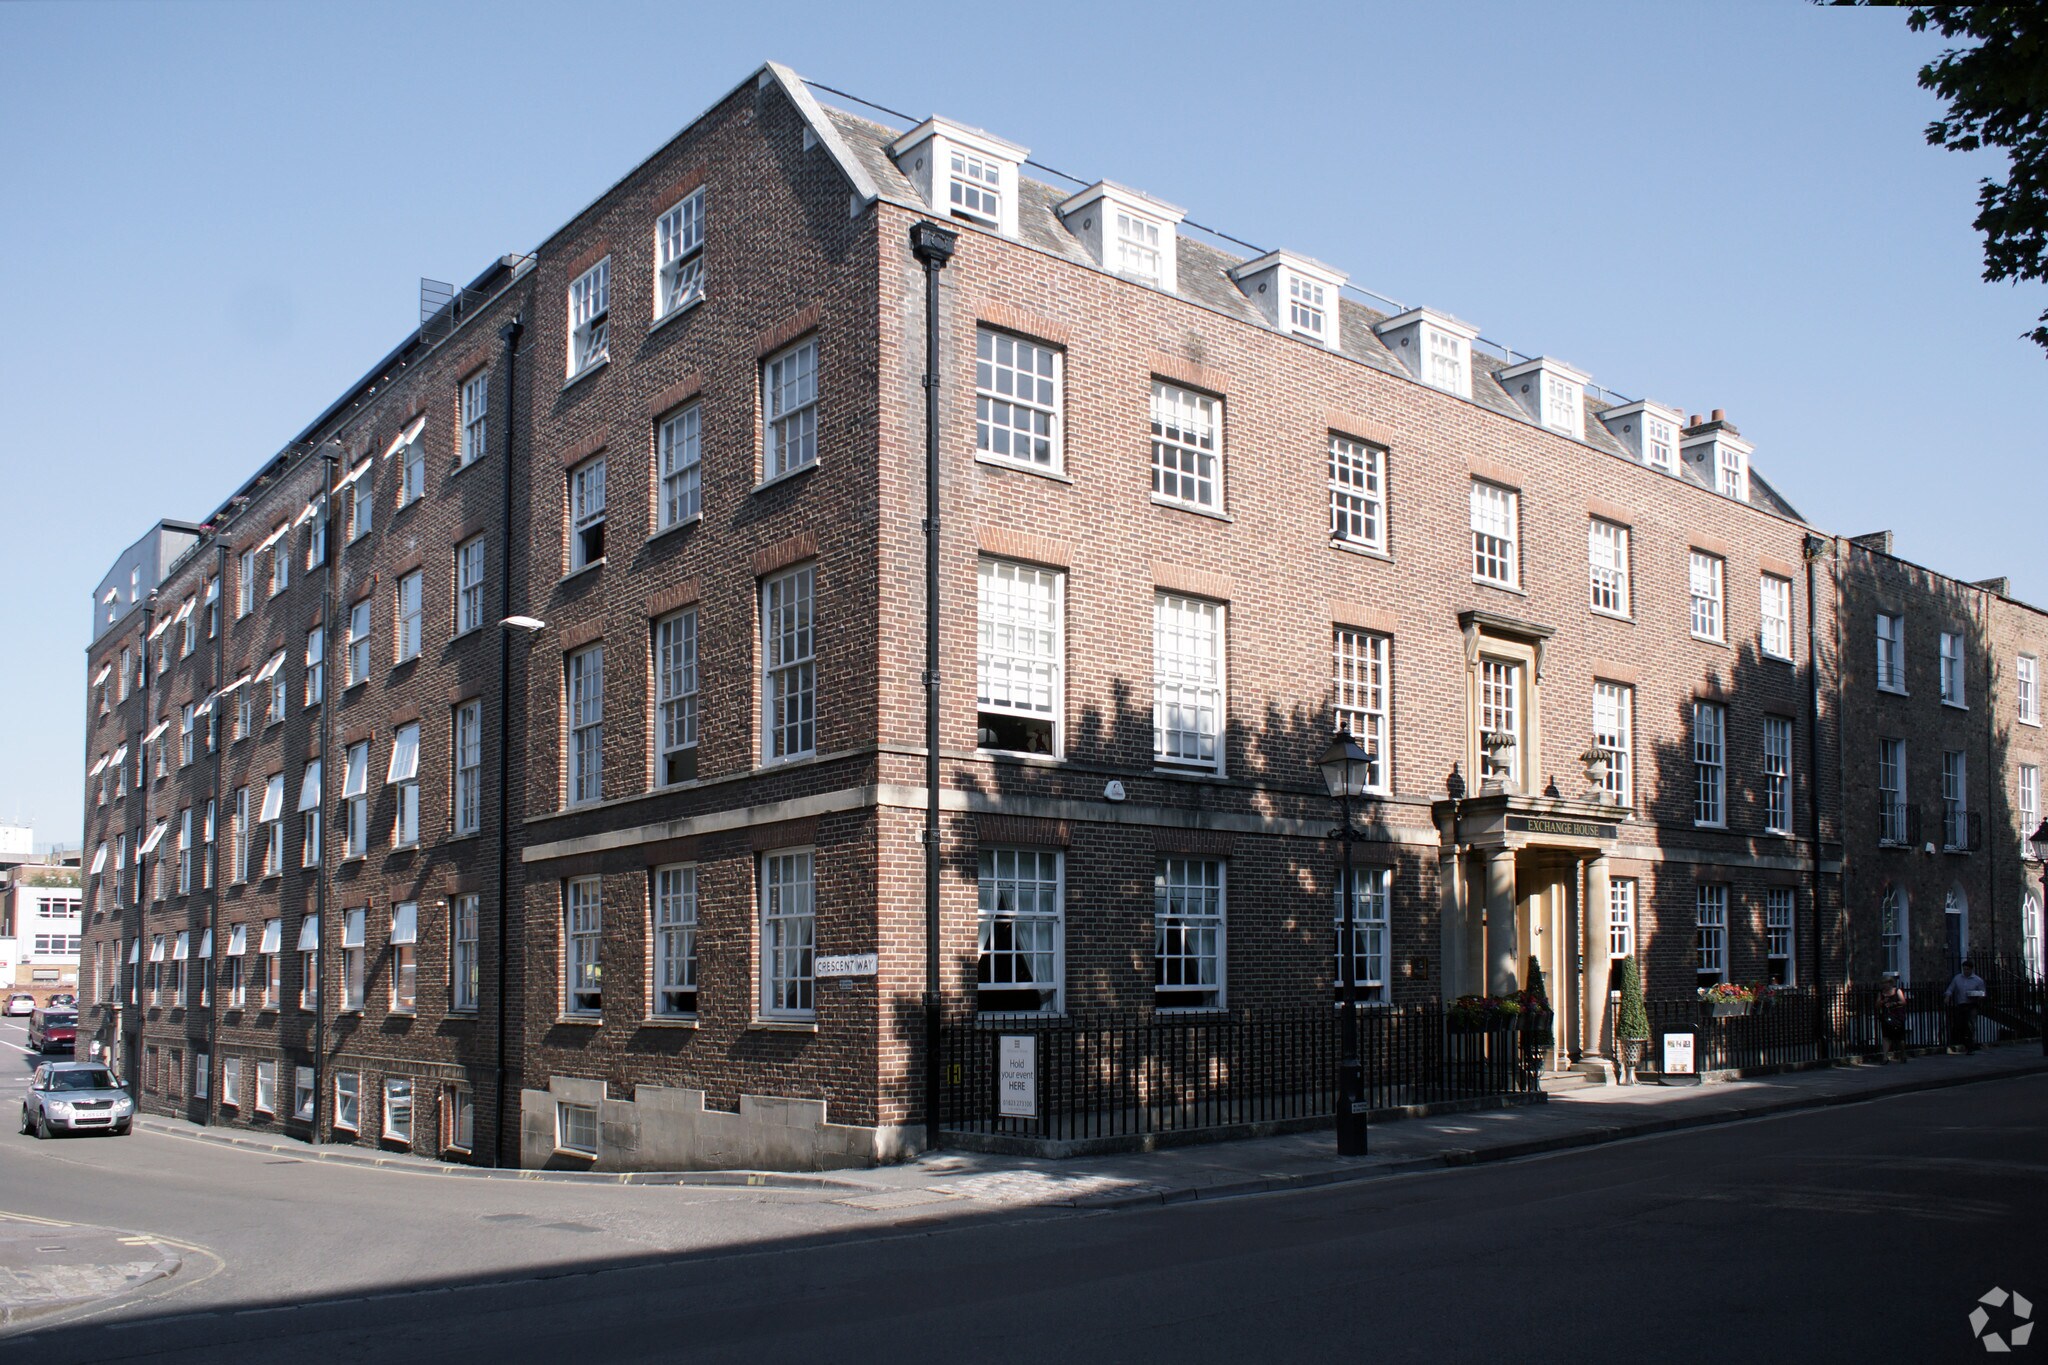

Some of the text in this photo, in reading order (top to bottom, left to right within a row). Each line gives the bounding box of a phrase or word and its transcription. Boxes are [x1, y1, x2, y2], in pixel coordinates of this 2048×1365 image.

[1527, 820, 1599, 836] EXCHANGE HOUSE
[817, 959, 874, 972] CRESCENT WAY
[1009, 1059, 1025, 1068] Hold
[1001, 1071, 1034, 1080] your event
[1008, 1080, 1026, 1090] HERE
